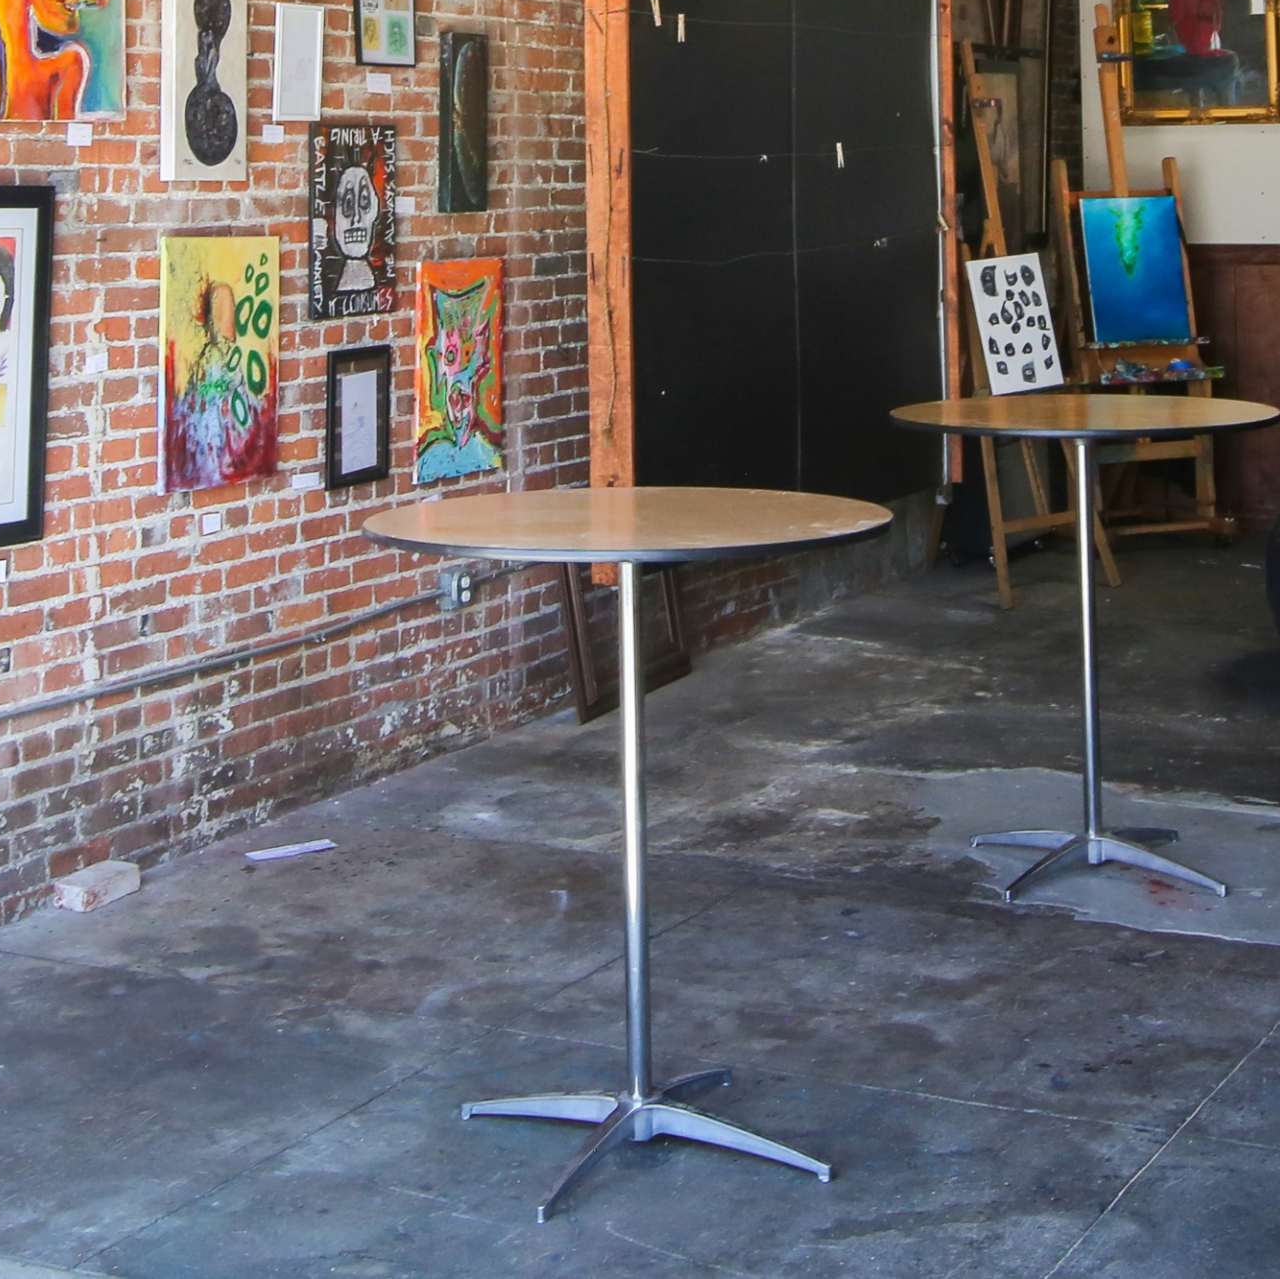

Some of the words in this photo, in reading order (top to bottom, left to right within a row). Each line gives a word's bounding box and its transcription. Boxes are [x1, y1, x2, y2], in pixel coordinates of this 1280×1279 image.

[313, 136, 329, 217] BATTLE
[384, 130, 396, 173] SUCH
[384, 182, 396, 246] ALWAYS
[385, 253, 395, 278] ME
